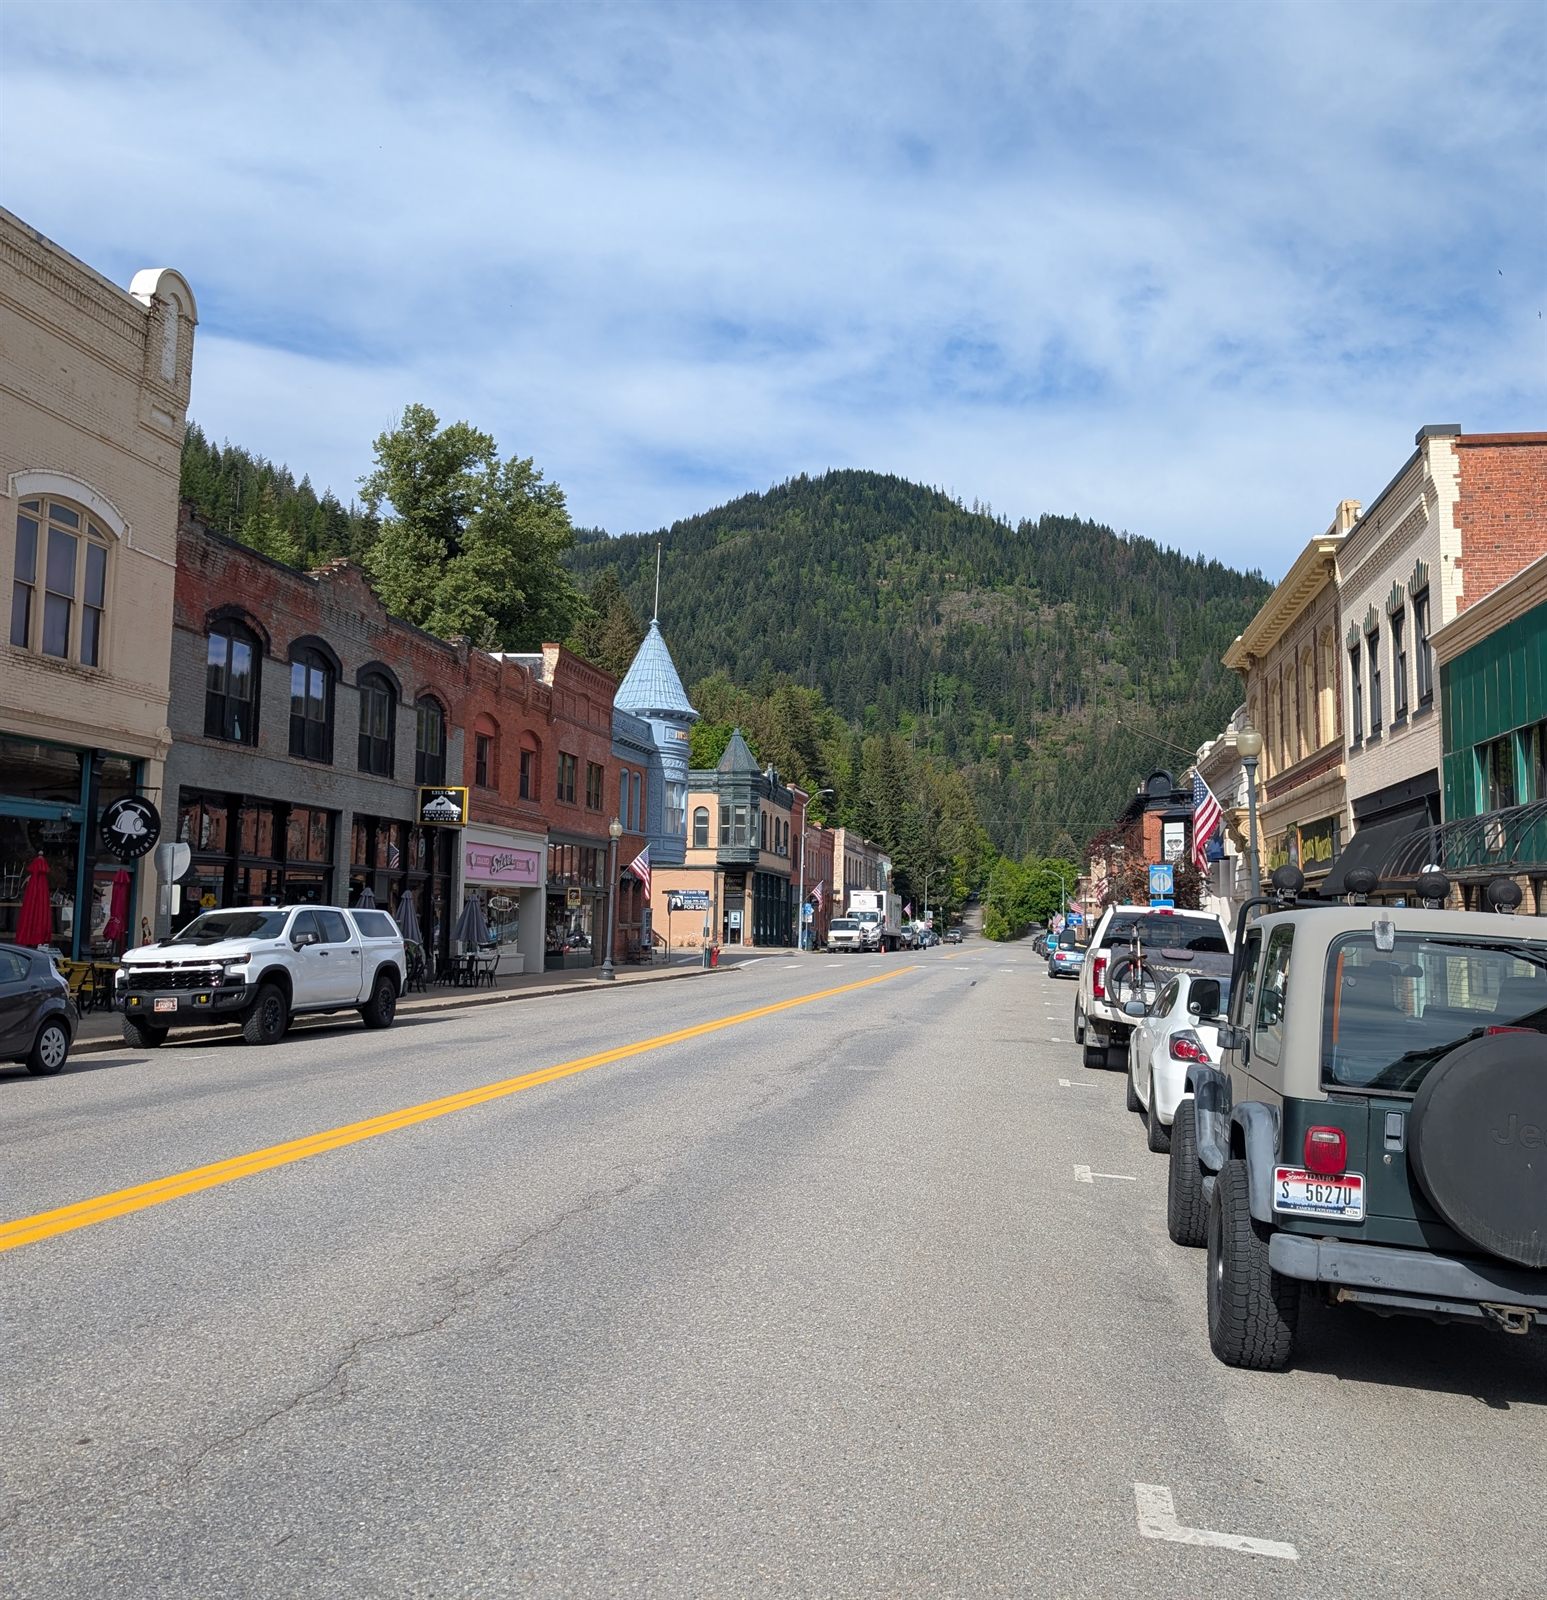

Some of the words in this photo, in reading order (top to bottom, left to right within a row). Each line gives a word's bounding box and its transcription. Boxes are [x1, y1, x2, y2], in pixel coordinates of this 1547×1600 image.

[130, 829, 157, 857] BREWING
[1489, 1112, 1547, 1149] Je
[1285, 1171, 1307, 1181] Scenic
[1305, 1172, 1336, 1183] IDAHO
[1282, 1181, 1290, 1199] S
[1306, 1183, 1352, 1206] 5627U
